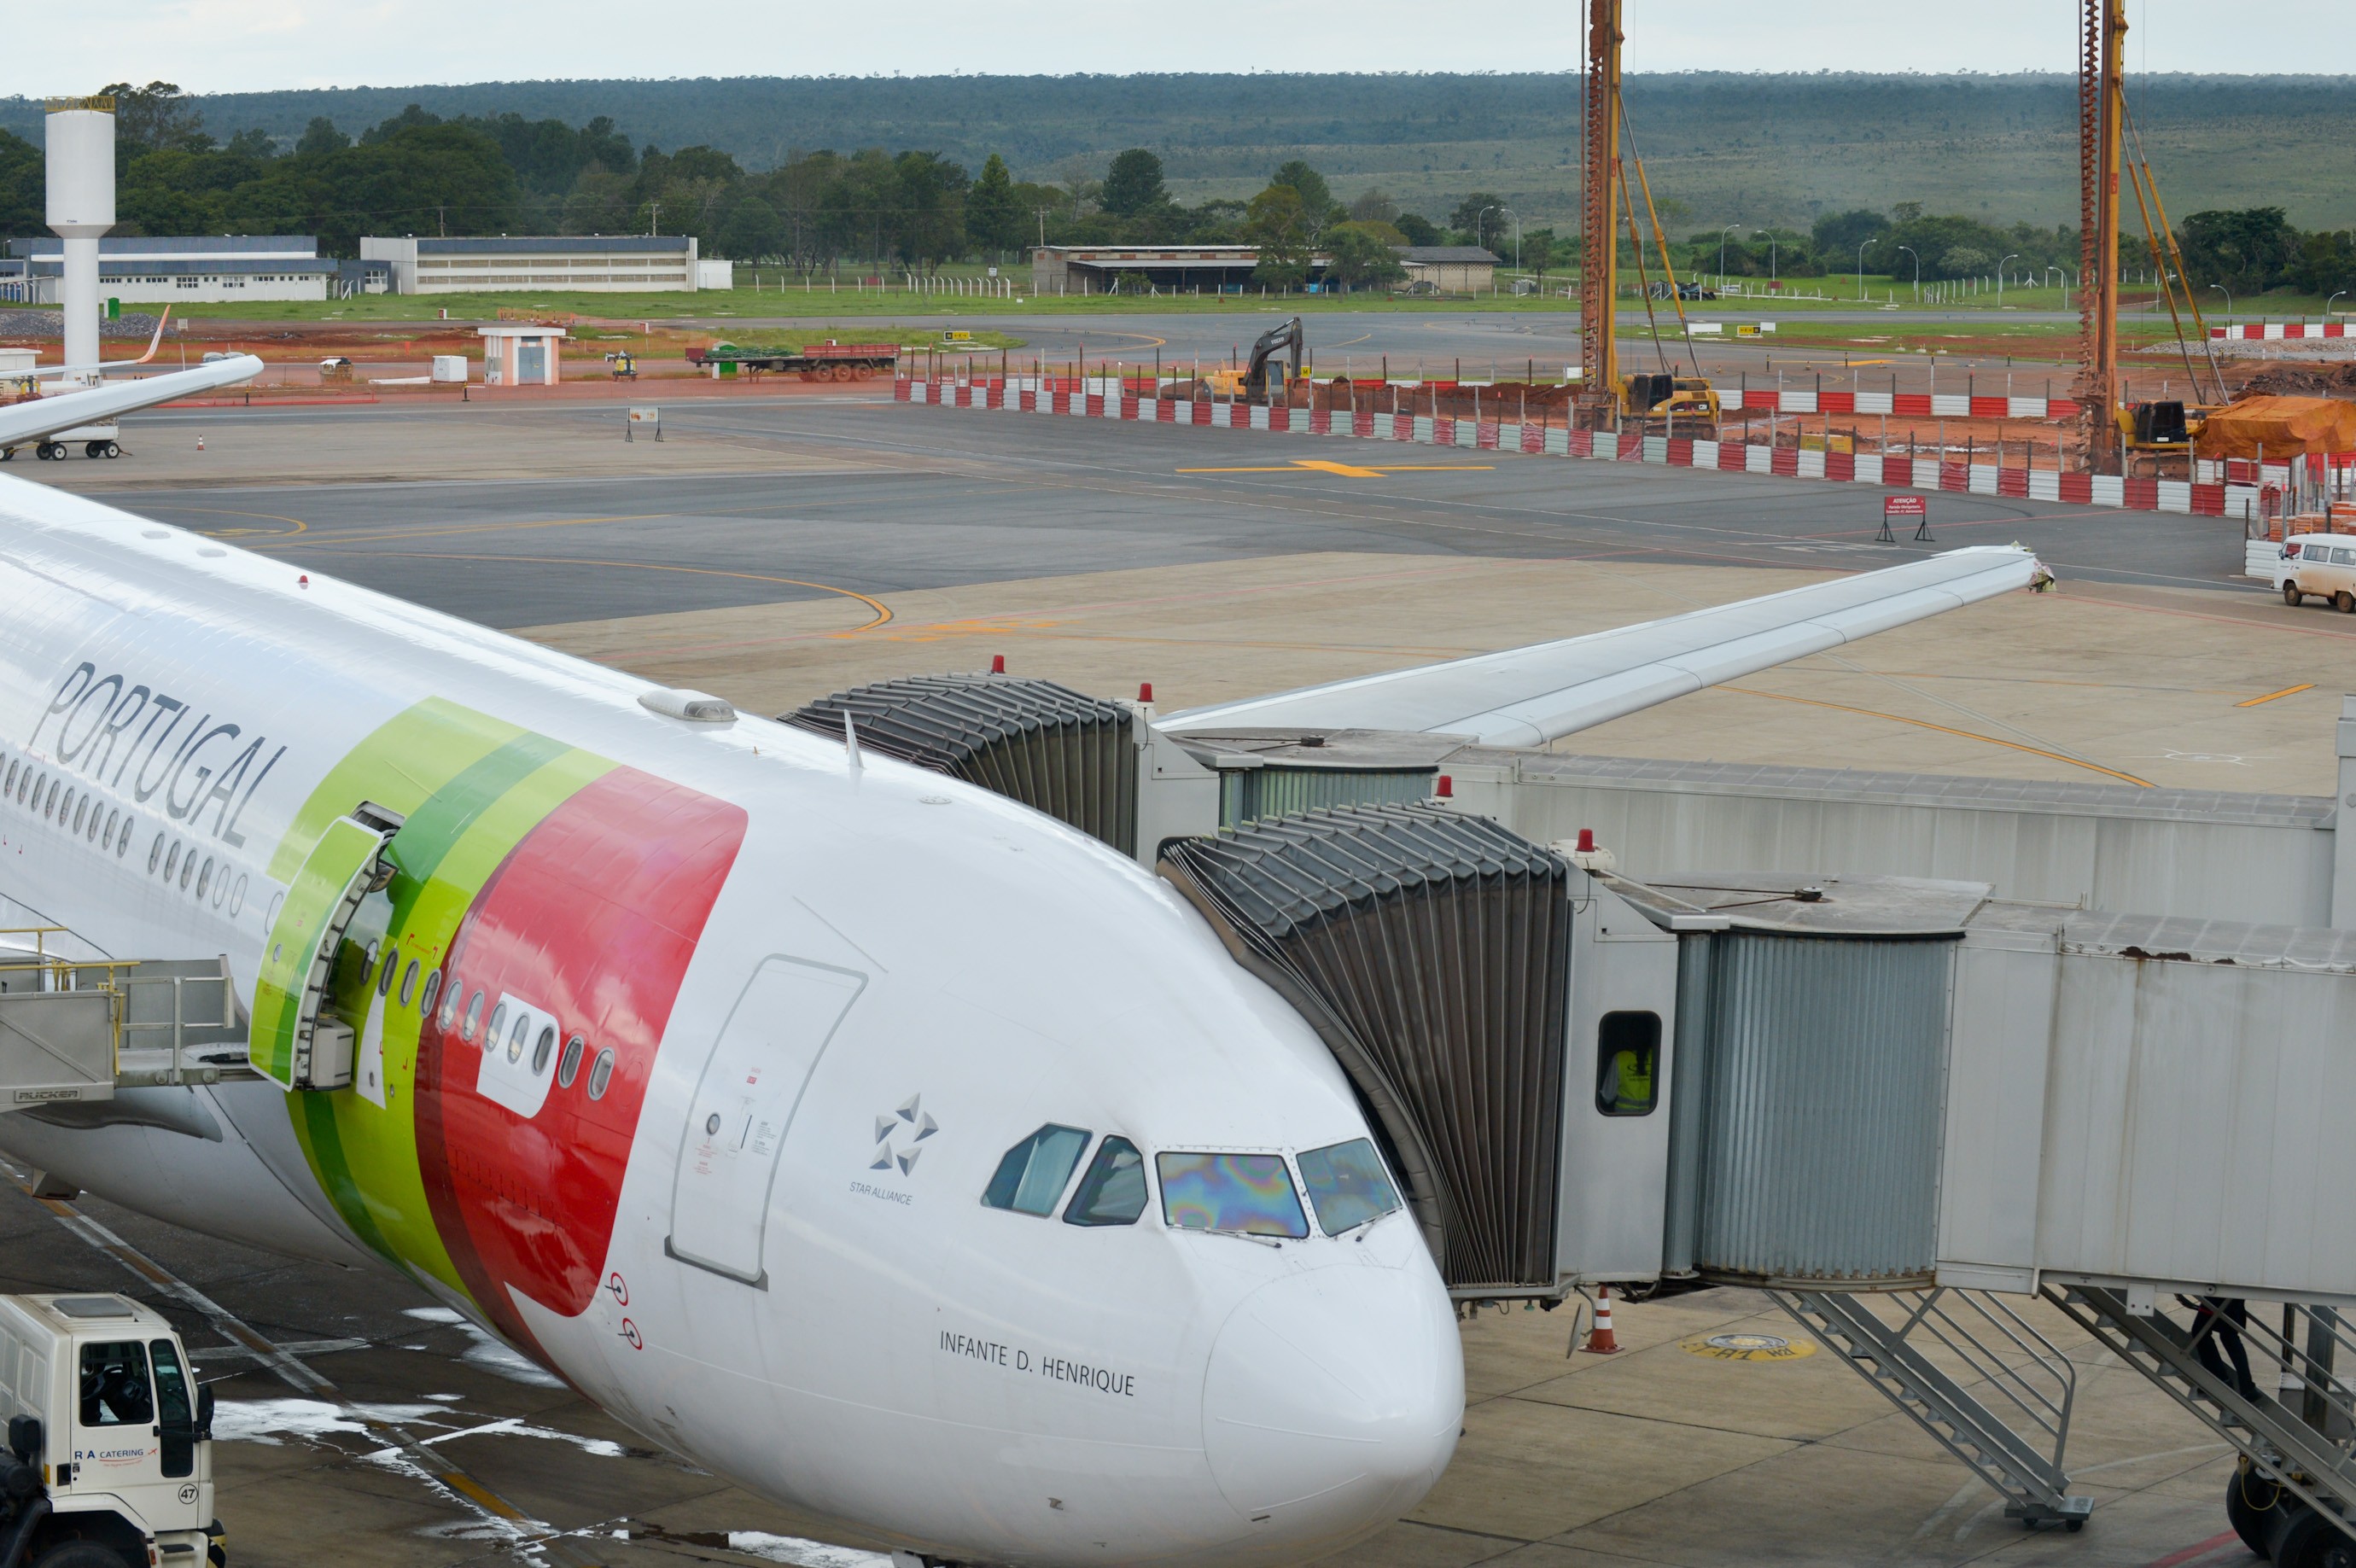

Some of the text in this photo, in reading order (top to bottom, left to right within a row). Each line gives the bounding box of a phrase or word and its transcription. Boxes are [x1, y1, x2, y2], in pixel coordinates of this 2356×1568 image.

[1271, 336, 1285, 345] VOLVO
[28, 662, 288, 849] PORTUGAL
[849, 1181, 913, 1205] STAR ALLIANCE
[940, 1330, 1135, 1396] INFANTE D. HENRIQUE
[74, 1449, 143, 1460] R A CATERING
[180, 1489, 195, 1499] 47
